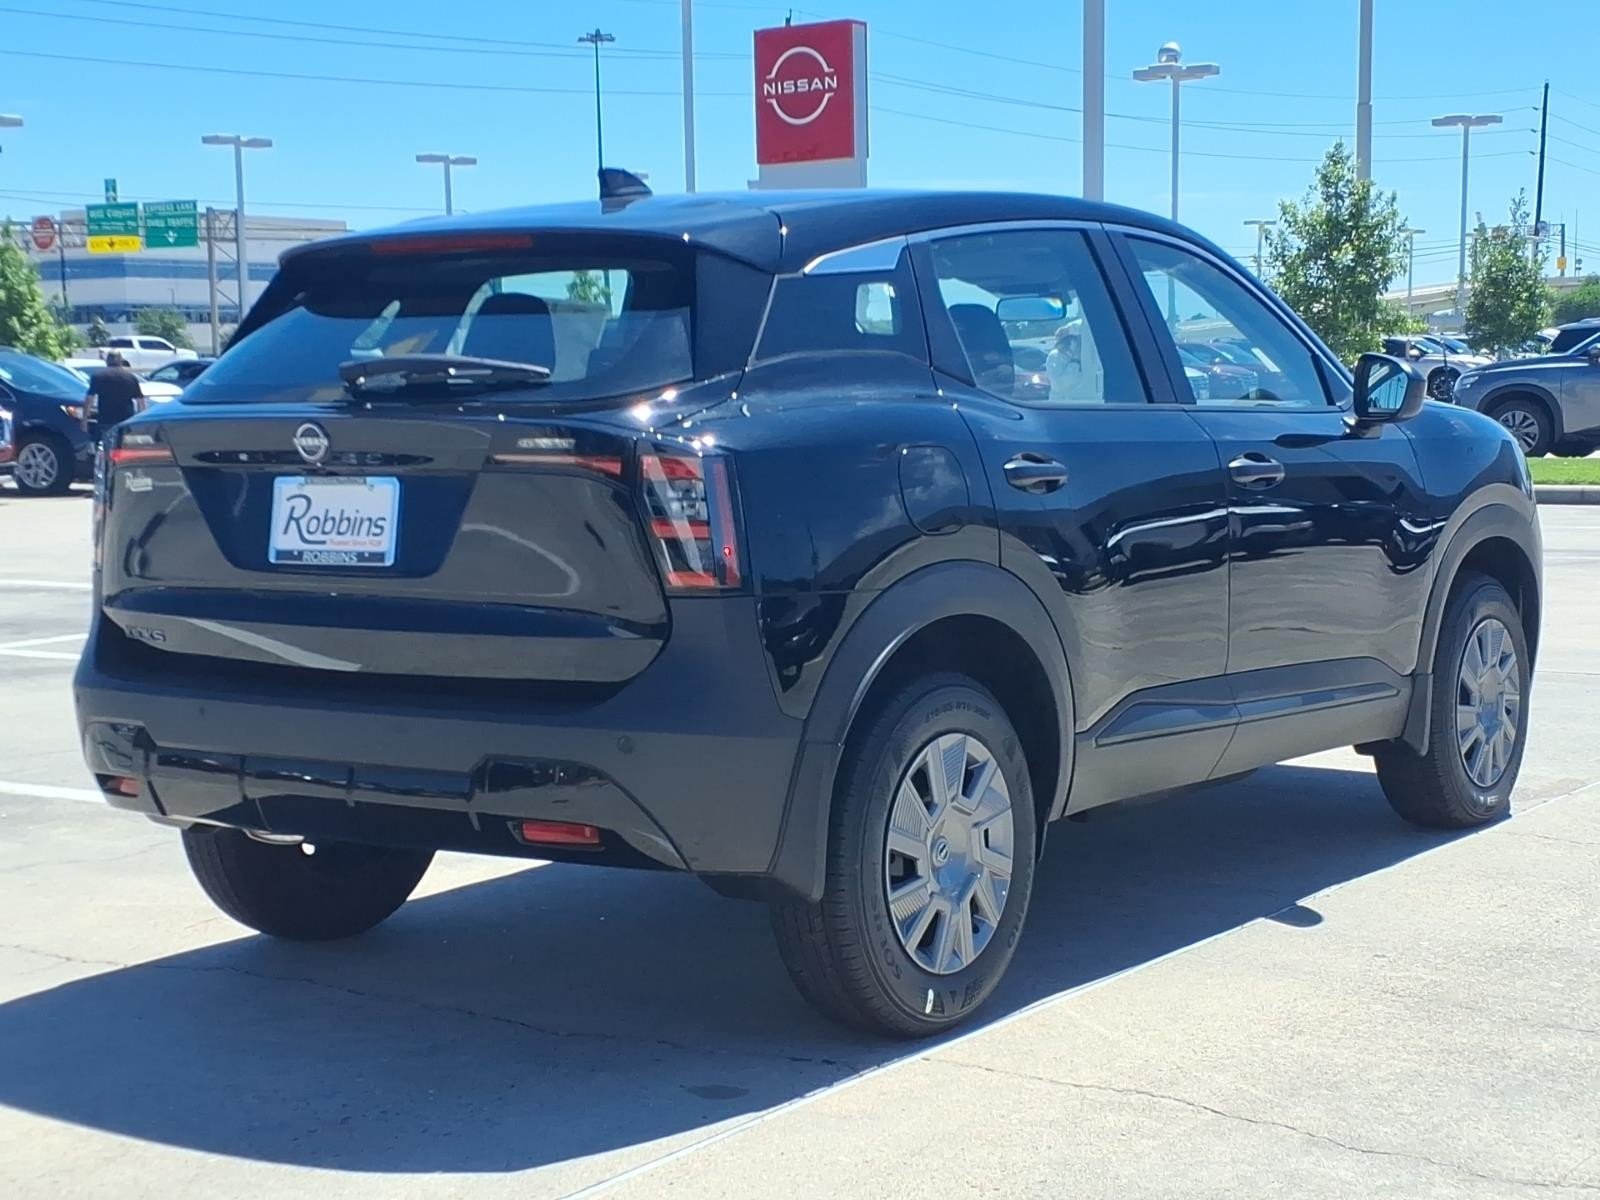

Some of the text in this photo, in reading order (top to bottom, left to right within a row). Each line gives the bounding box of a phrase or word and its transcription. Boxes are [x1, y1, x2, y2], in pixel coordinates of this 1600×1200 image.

[763, 75, 838, 97] NISSAN
[176, 202, 194, 211] LANE
[283, 493, 387, 545] Robbins
[302, 550, 359, 563] ROBBINS
